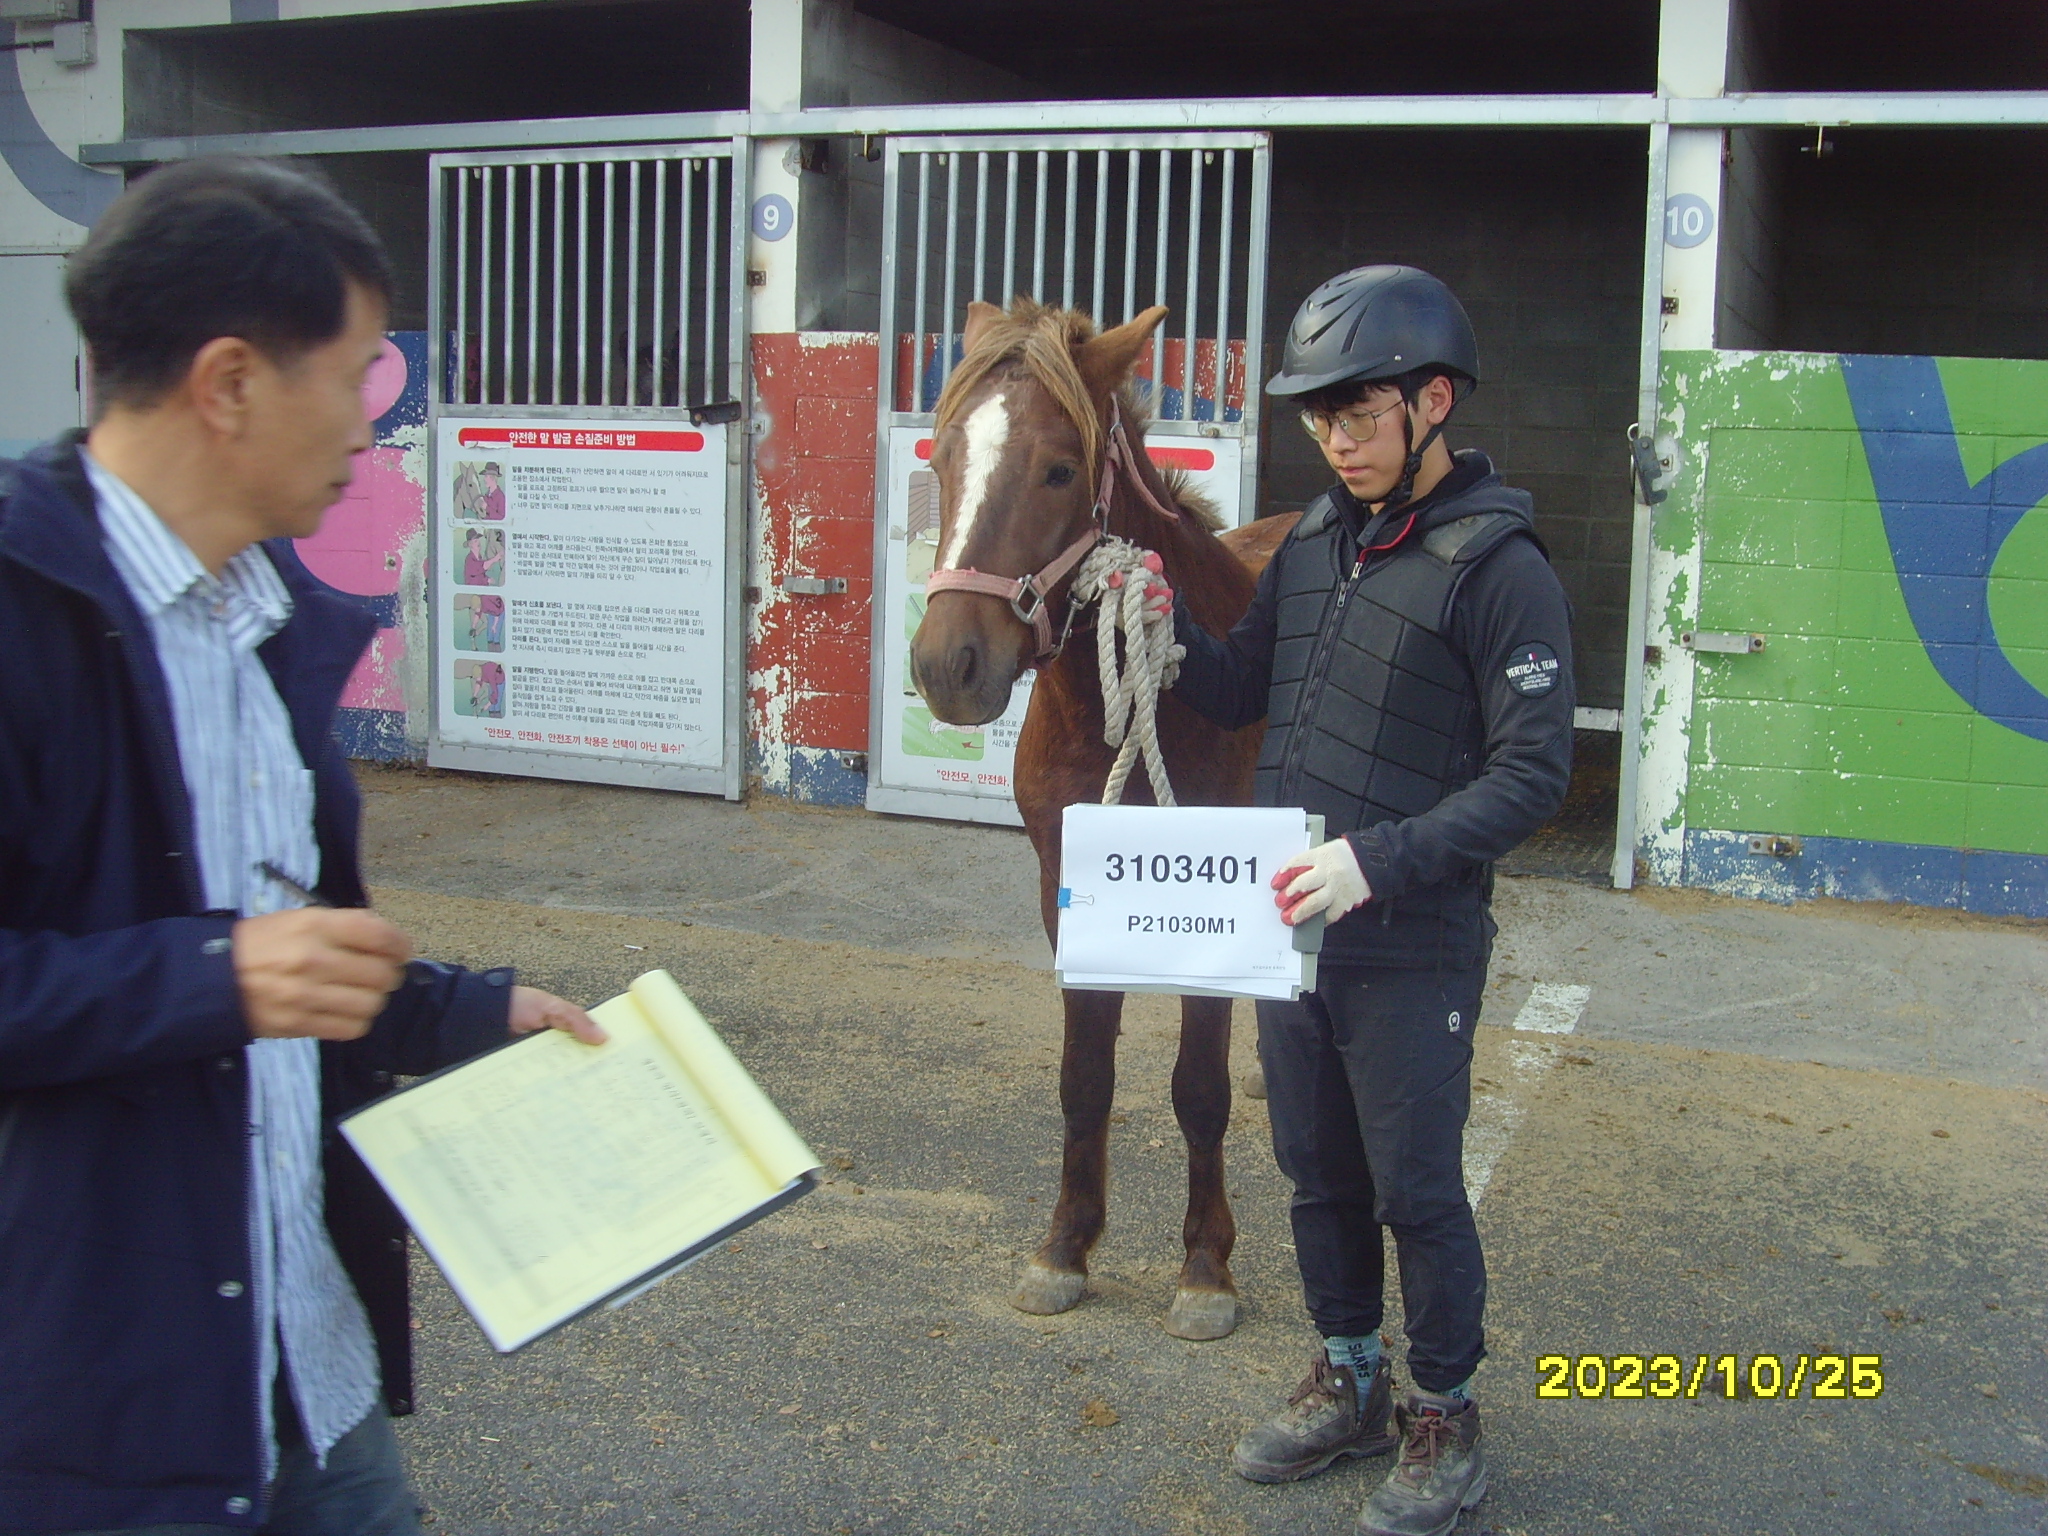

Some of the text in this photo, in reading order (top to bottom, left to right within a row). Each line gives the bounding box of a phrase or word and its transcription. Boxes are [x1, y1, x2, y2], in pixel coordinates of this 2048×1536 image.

[763, 204, 779, 231] 9
[1666, 206, 1704, 237] 10
[509, 432, 636, 446] 안전한 말 발굽 손질준비 방법
[1506, 662, 1541, 679] VERTICAL
[1541, 659, 1558, 671] TEAM
[518, 730, 545, 743] 안전화,
[548, 733, 581, 745] 안전조끼
[584, 735, 609, 748] 착용은
[612, 738, 637, 750] 선택이
[640, 741, 657, 752] 아닌
[992, 739, 1010, 748] 시간을
[977, 773, 1010, 787] 안전화,
[1105, 853, 1257, 884] 3103401
[1128, 915, 1235, 934] P21030M1
